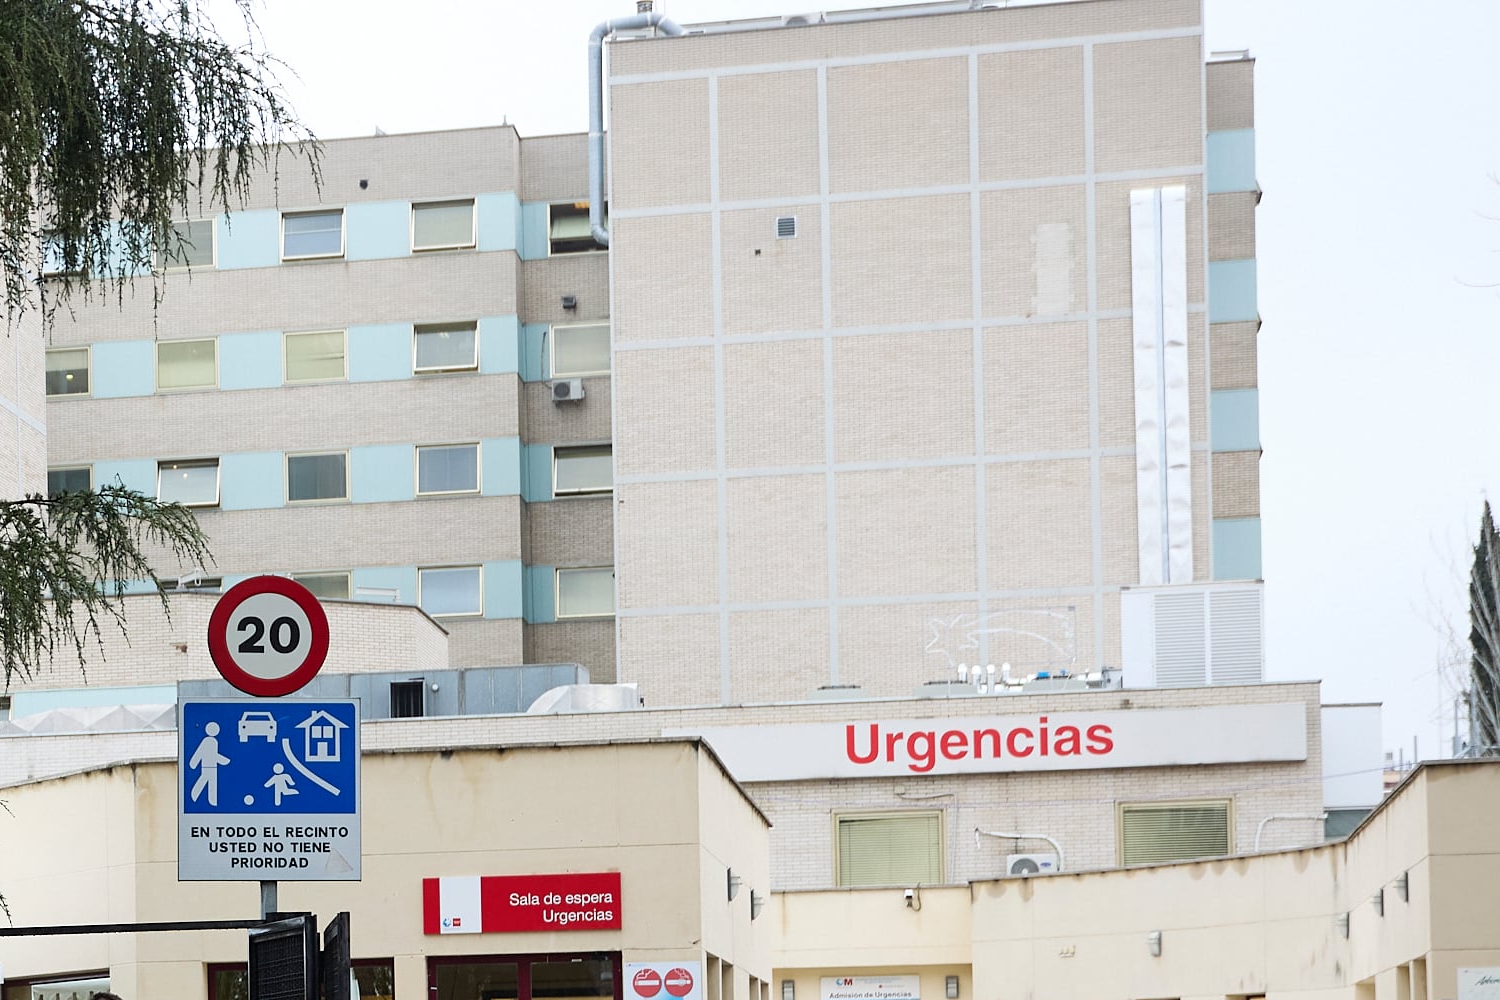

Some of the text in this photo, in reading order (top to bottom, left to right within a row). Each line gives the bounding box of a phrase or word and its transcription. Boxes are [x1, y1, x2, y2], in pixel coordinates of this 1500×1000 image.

[237, 616, 300, 654] 20
[845, 715, 1115, 773] Urgencias
[191, 827, 349, 838] EN TODO EL RECINTO
[209, 842, 331, 853] USTED NO TIENE
[231, 857, 309, 868] PRIORIDAD
[509, 892, 613, 906] Sala de espera
[543, 908, 613, 925] Urgencias
[874, 991, 912, 999] Urgencias
